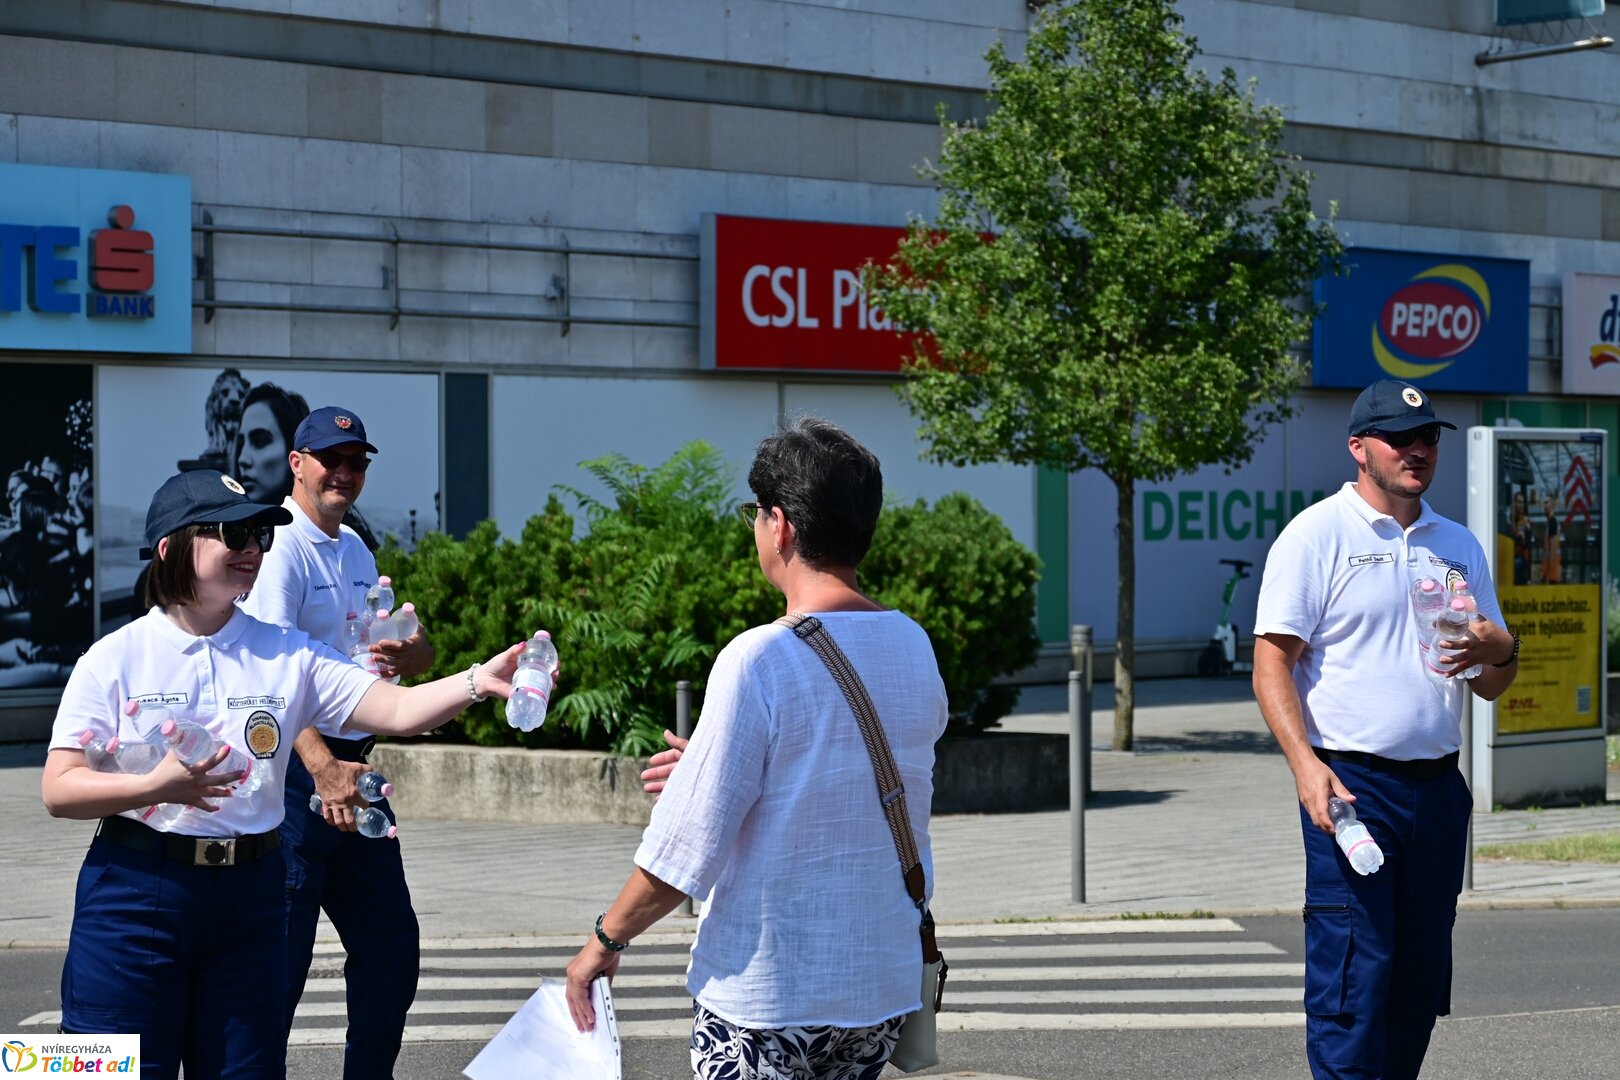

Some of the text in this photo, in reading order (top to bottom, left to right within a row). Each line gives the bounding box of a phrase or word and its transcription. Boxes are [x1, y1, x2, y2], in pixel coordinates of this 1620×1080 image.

[95, 294, 154, 319] BANK
[741, 264, 819, 328] CSL
[1390, 302, 1474, 341] PEPCO
[1600, 294, 1620, 343] d
